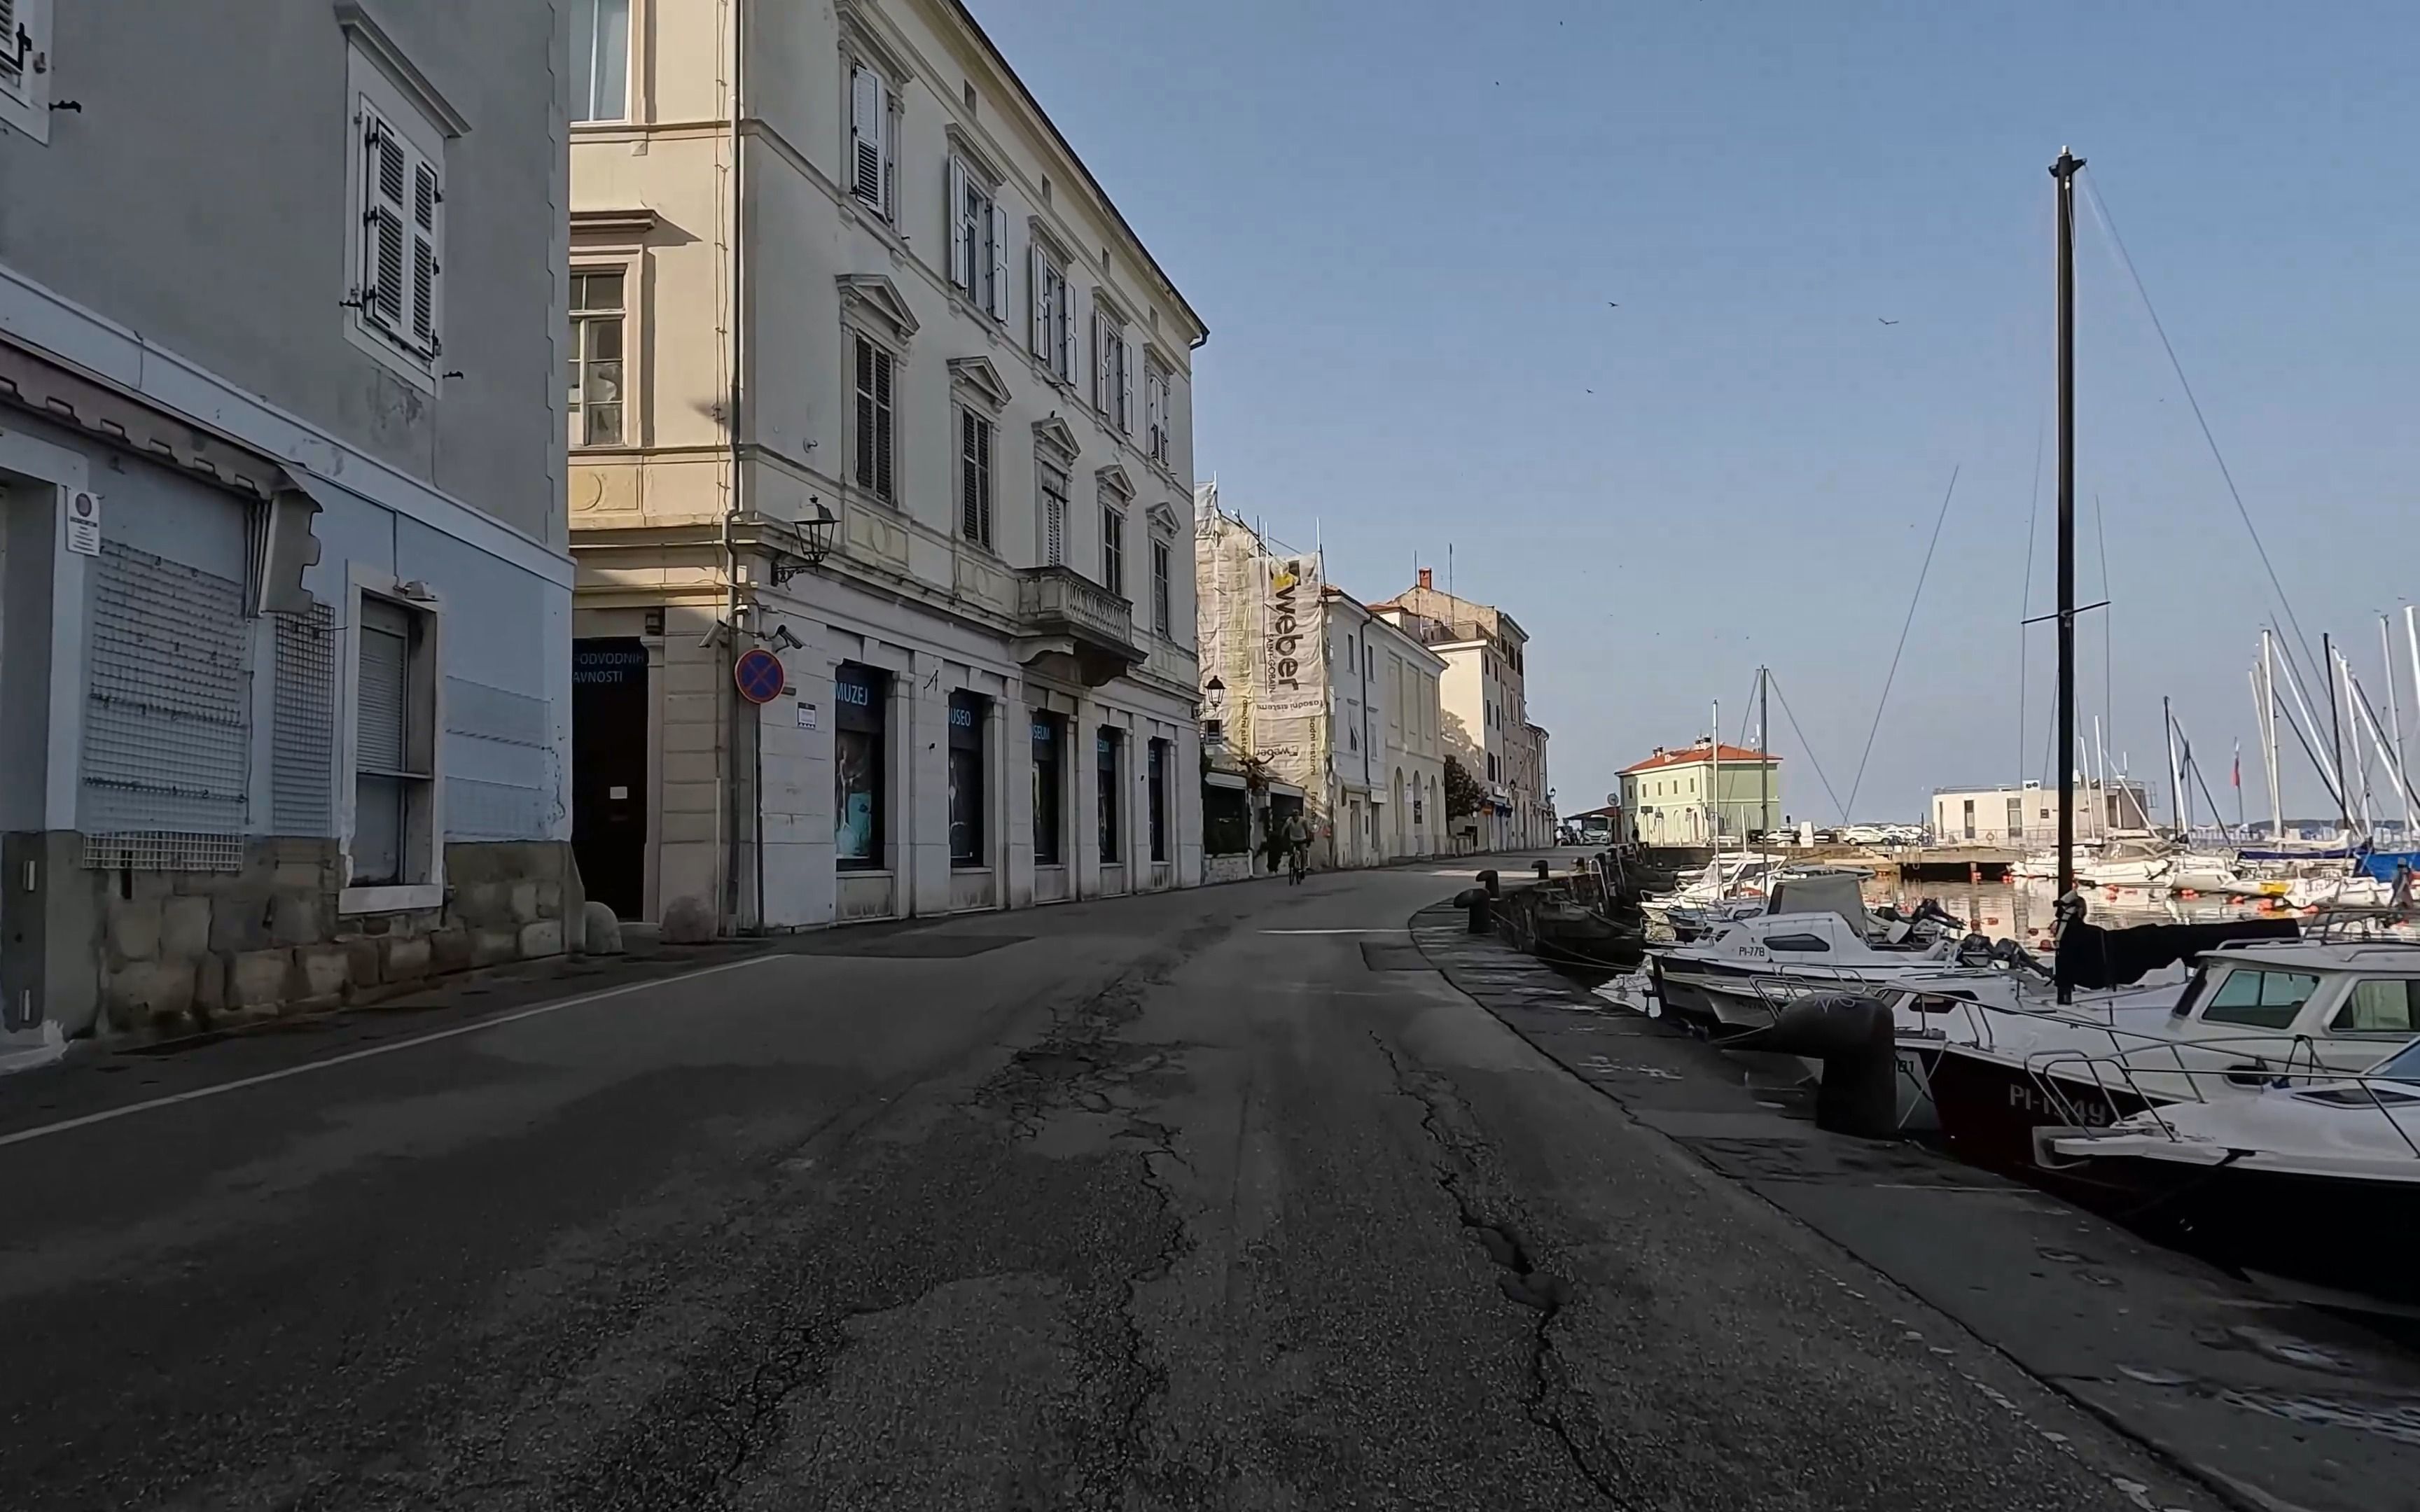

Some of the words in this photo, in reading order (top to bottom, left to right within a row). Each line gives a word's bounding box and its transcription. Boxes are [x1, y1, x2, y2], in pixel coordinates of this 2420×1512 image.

[1275, 585, 1304, 691] weber
[1266, 634, 1277, 694] SAINT-GOBAIN
[835, 682, 868, 706] MUZEJ
[948, 707, 971, 727] USEO
[1032, 724, 1050, 740] SEUM
[1241, 729, 1249, 760] sistem
[1893, 1060, 1914, 1072] 81
